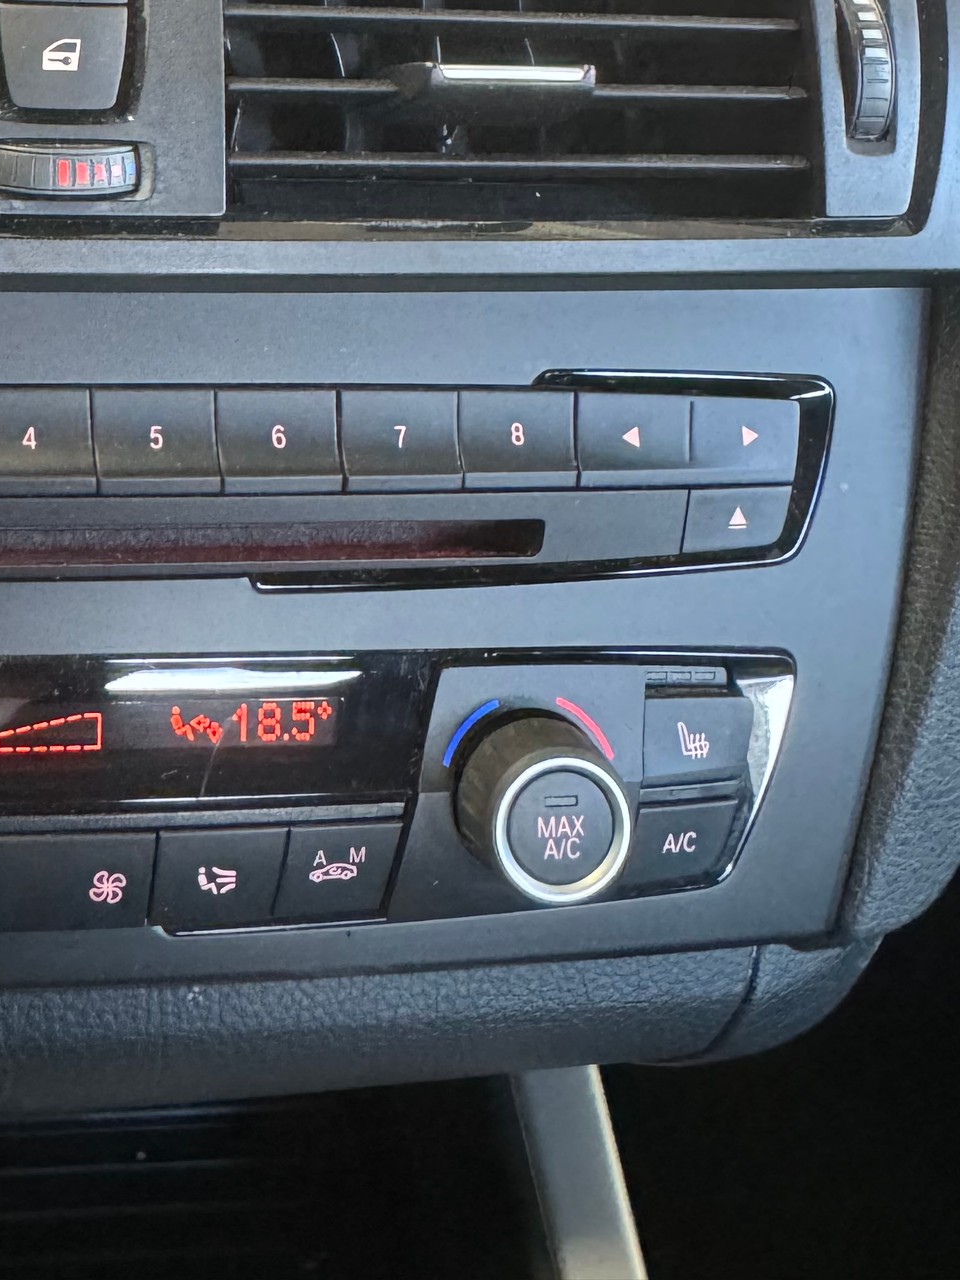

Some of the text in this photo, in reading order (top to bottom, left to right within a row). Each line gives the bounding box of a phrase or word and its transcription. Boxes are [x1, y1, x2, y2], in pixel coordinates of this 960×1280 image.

[21, 426, 37, 450] 4
[149, 425, 164, 450] 5
[271, 424, 287, 449] 6
[393, 425, 407, 449] 7
[510, 422, 525, 446] 8
[537, 815, 585, 839] MAX
[544, 837, 581, 860] A/C
[661, 831, 697, 854] A/C
[313, 846, 366, 867] A M
